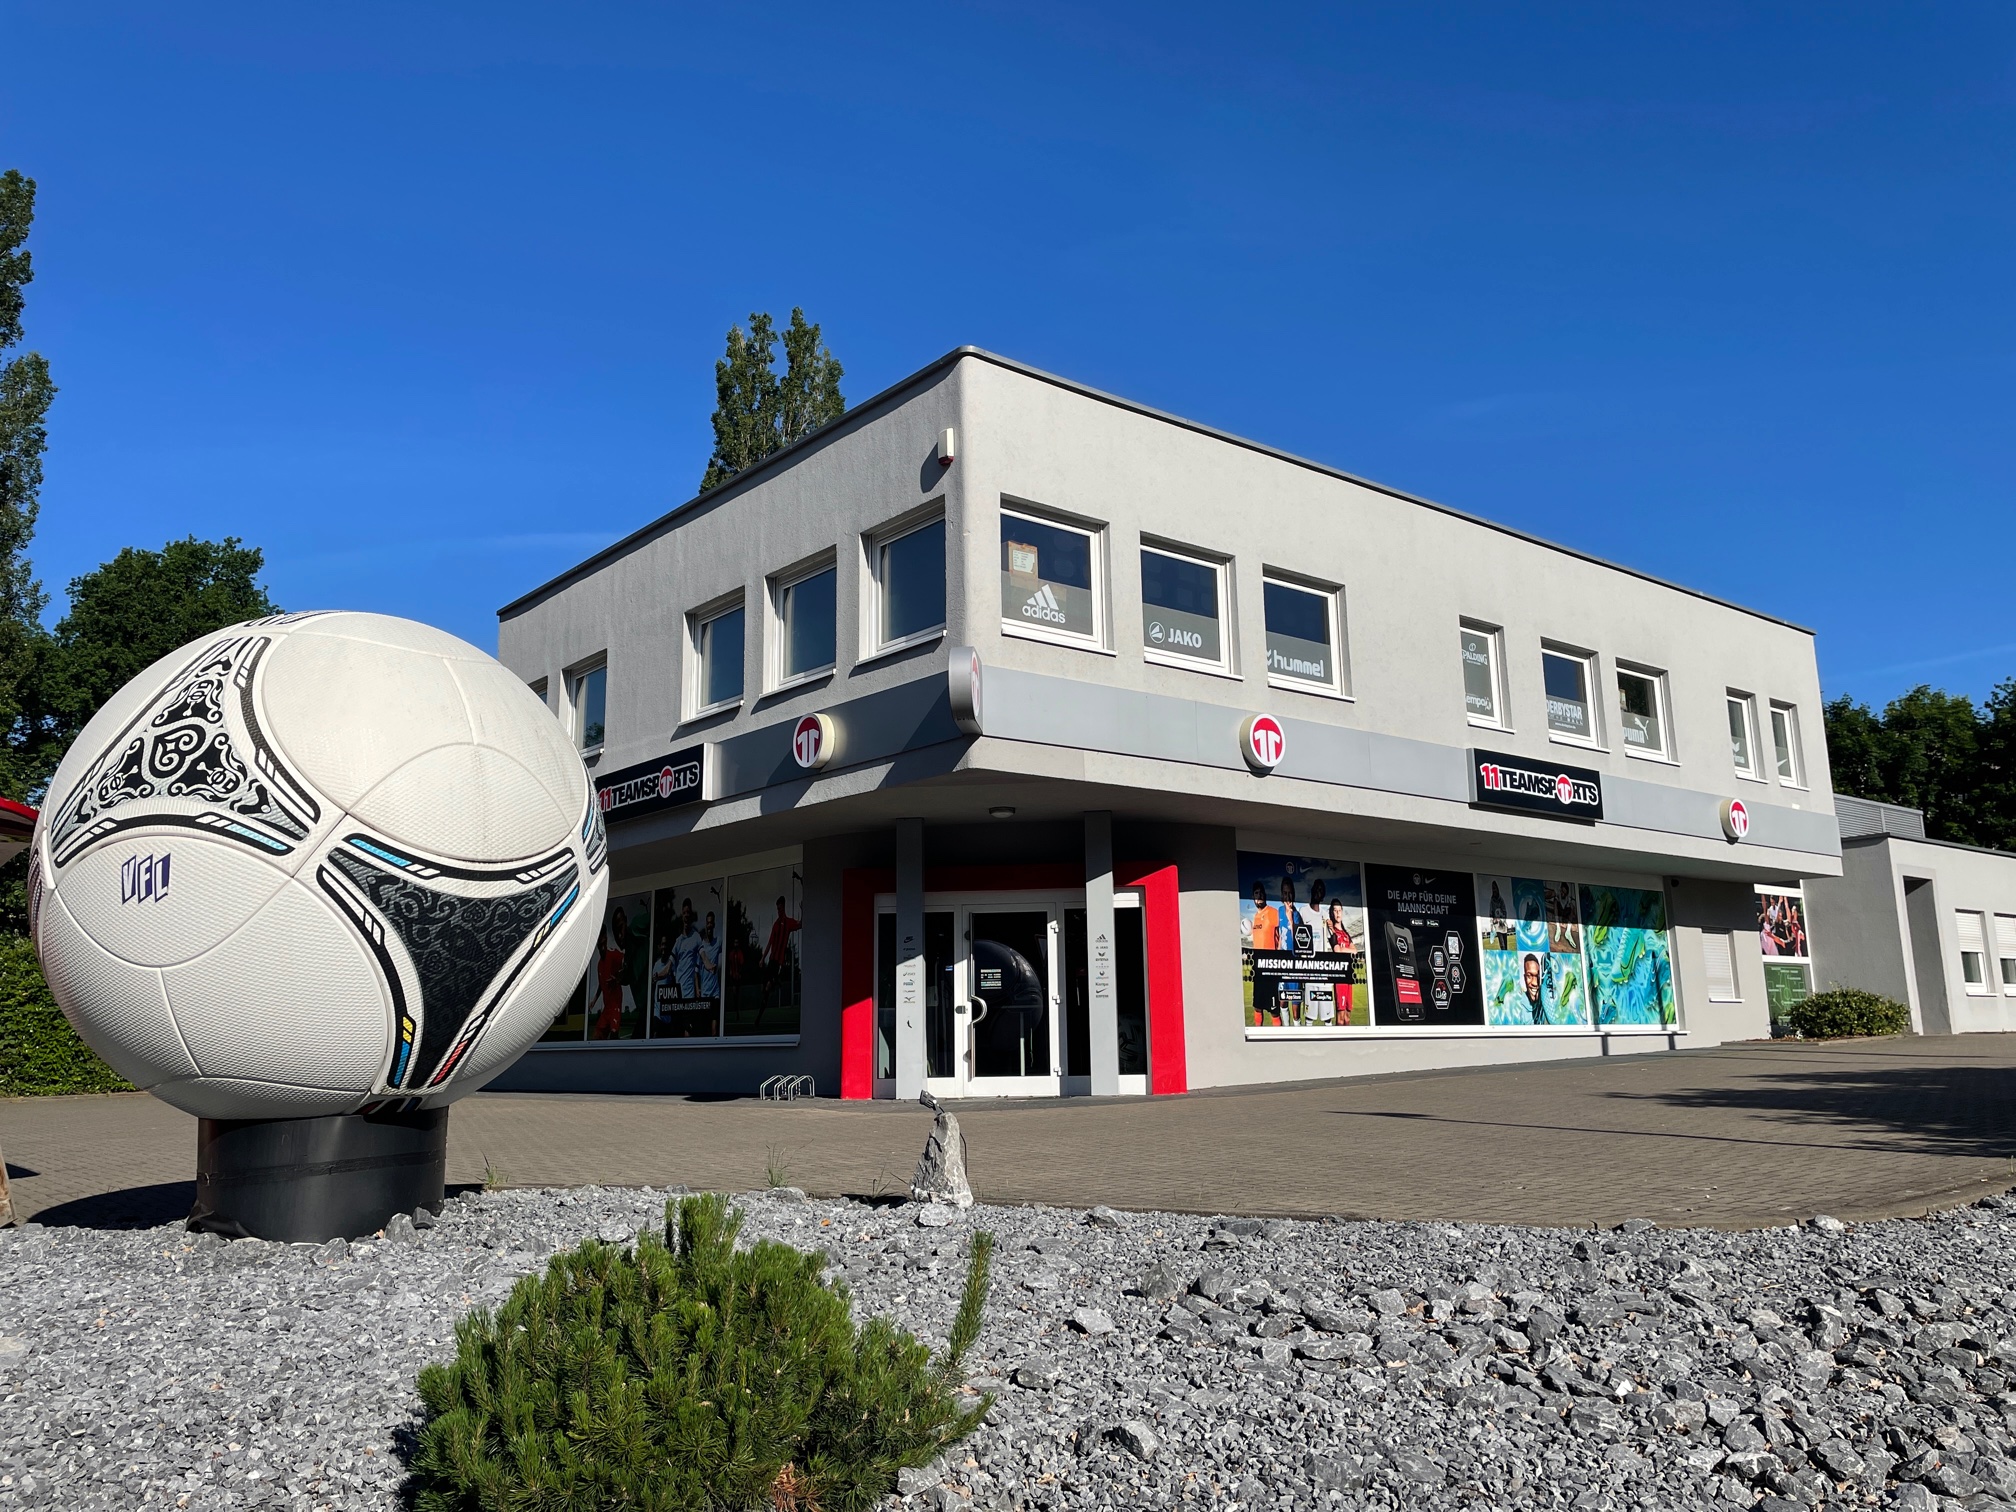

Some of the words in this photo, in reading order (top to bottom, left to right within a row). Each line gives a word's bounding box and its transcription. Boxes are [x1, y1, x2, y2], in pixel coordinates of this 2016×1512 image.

[1022, 603, 1066, 624] adidas
[1168, 628, 1202, 649] JAKO
[1273, 650, 1325, 678] hummel
[122, 853, 171, 905] VFL
[1387, 890, 1401, 900] DIE
[1403, 891, 1417, 901] APP
[1419, 891, 1434, 902] FÜR
[1435, 894, 1457, 904] DEINE
[1397, 902, 1449, 914] MANNSCHAFT
[1257, 958, 1294, 969] MISSION
[1295, 960, 1349, 971] MANNSCHAFT
[658, 987, 678, 999] PUMA
[661, 1003, 671, 1011] DEIN
